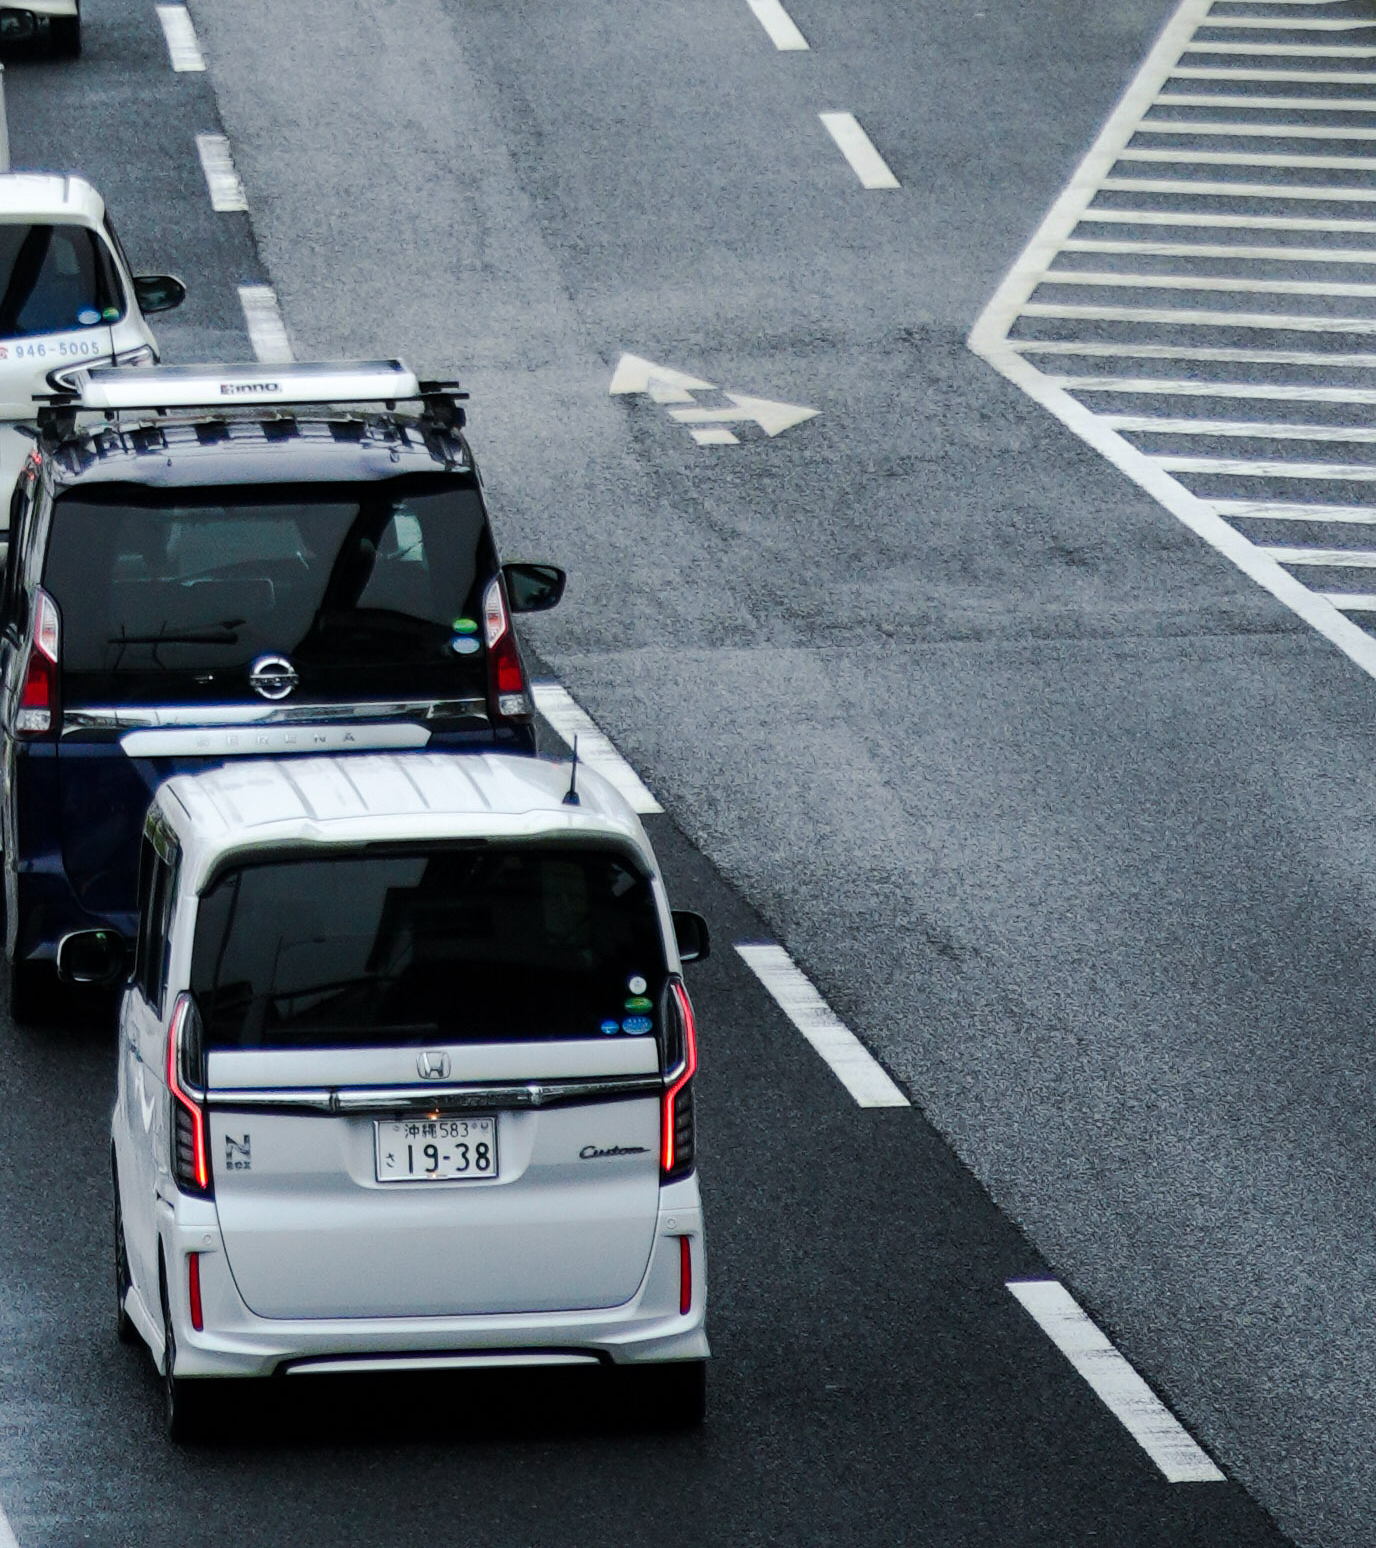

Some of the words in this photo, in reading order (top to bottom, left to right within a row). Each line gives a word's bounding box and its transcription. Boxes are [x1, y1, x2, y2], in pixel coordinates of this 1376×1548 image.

[15, 341, 100, 359] 946-5005
[403, 1122, 471, 1139] 沖縄583
[405, 1142, 492, 1174] 19-38
[578, 1144, 650, 1160] Custom
